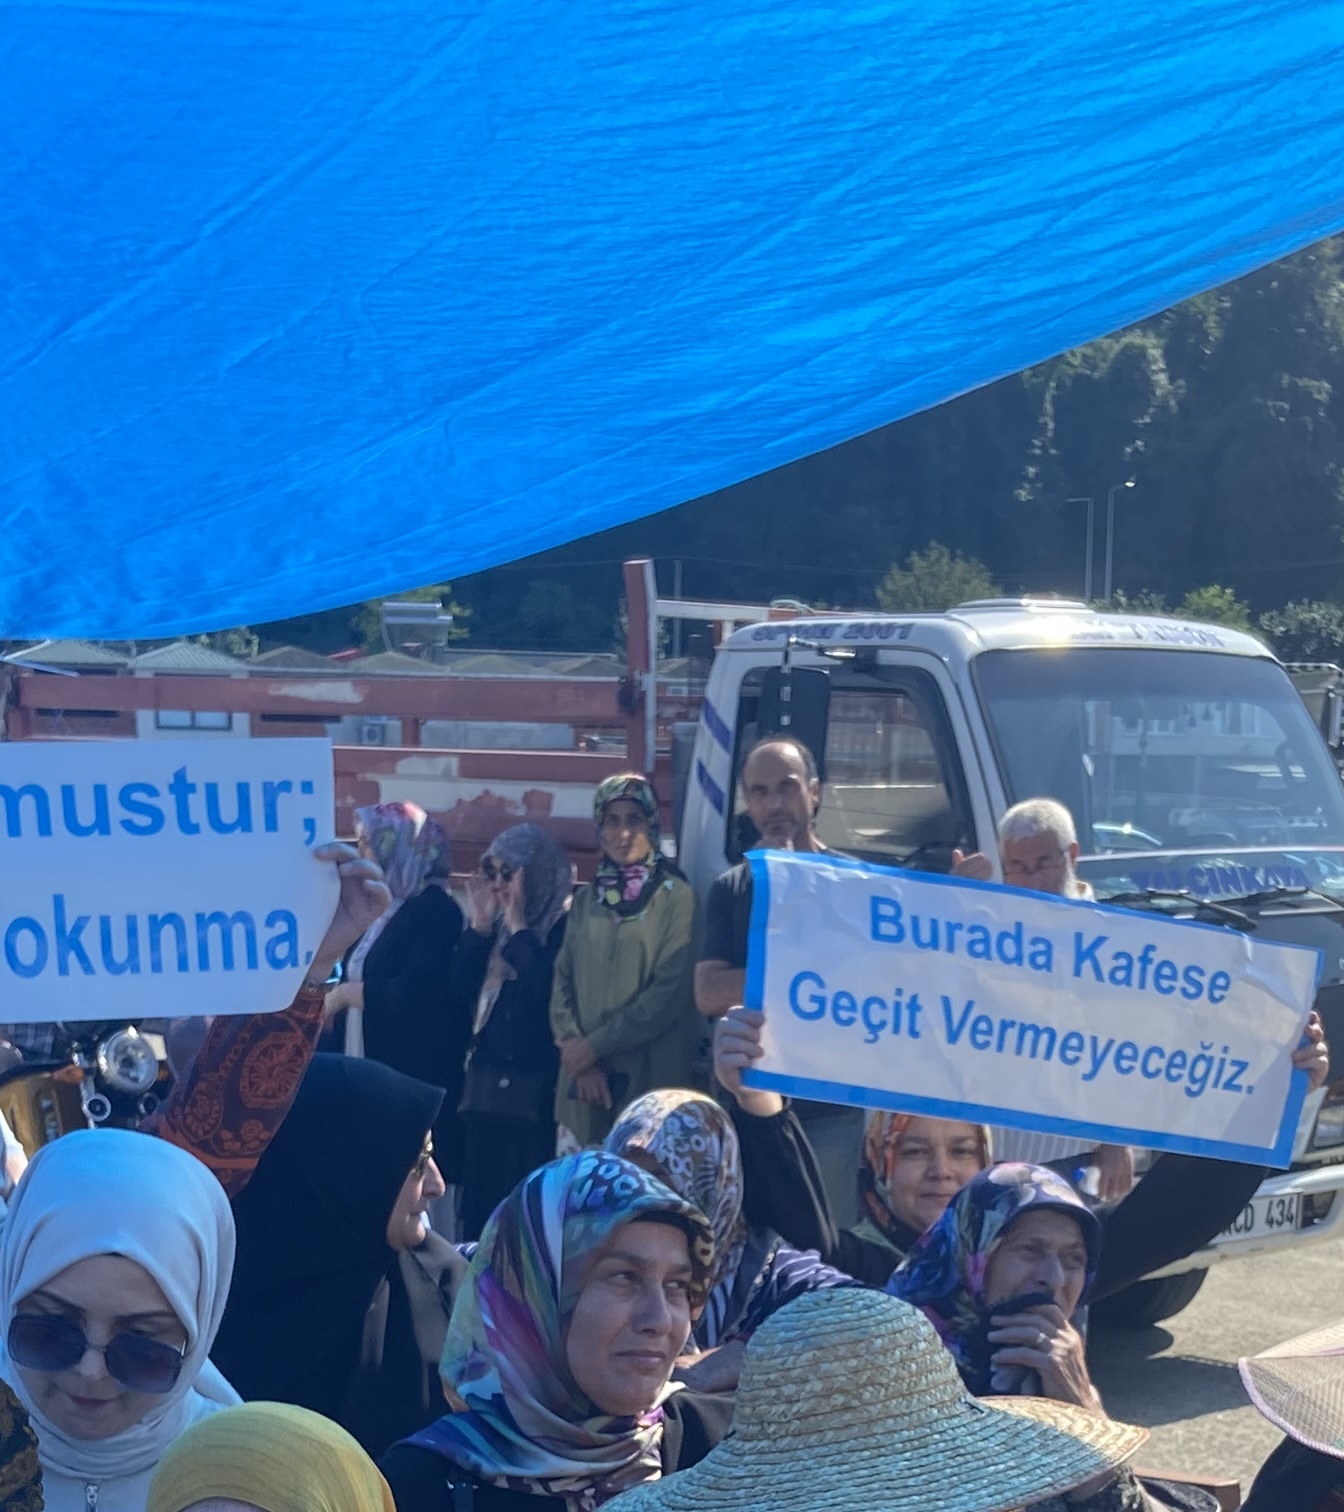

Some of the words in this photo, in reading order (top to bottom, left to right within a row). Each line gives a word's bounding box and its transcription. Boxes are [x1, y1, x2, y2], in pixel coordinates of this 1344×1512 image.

[870, 895, 1052, 972] Burada
[1073, 932, 1231, 1004] Kafese
[789, 971, 922, 1043] Geçit
[940, 996, 1257, 1098] Vermeyeceğiz.
[1266, 1196, 1294, 1228] 434
